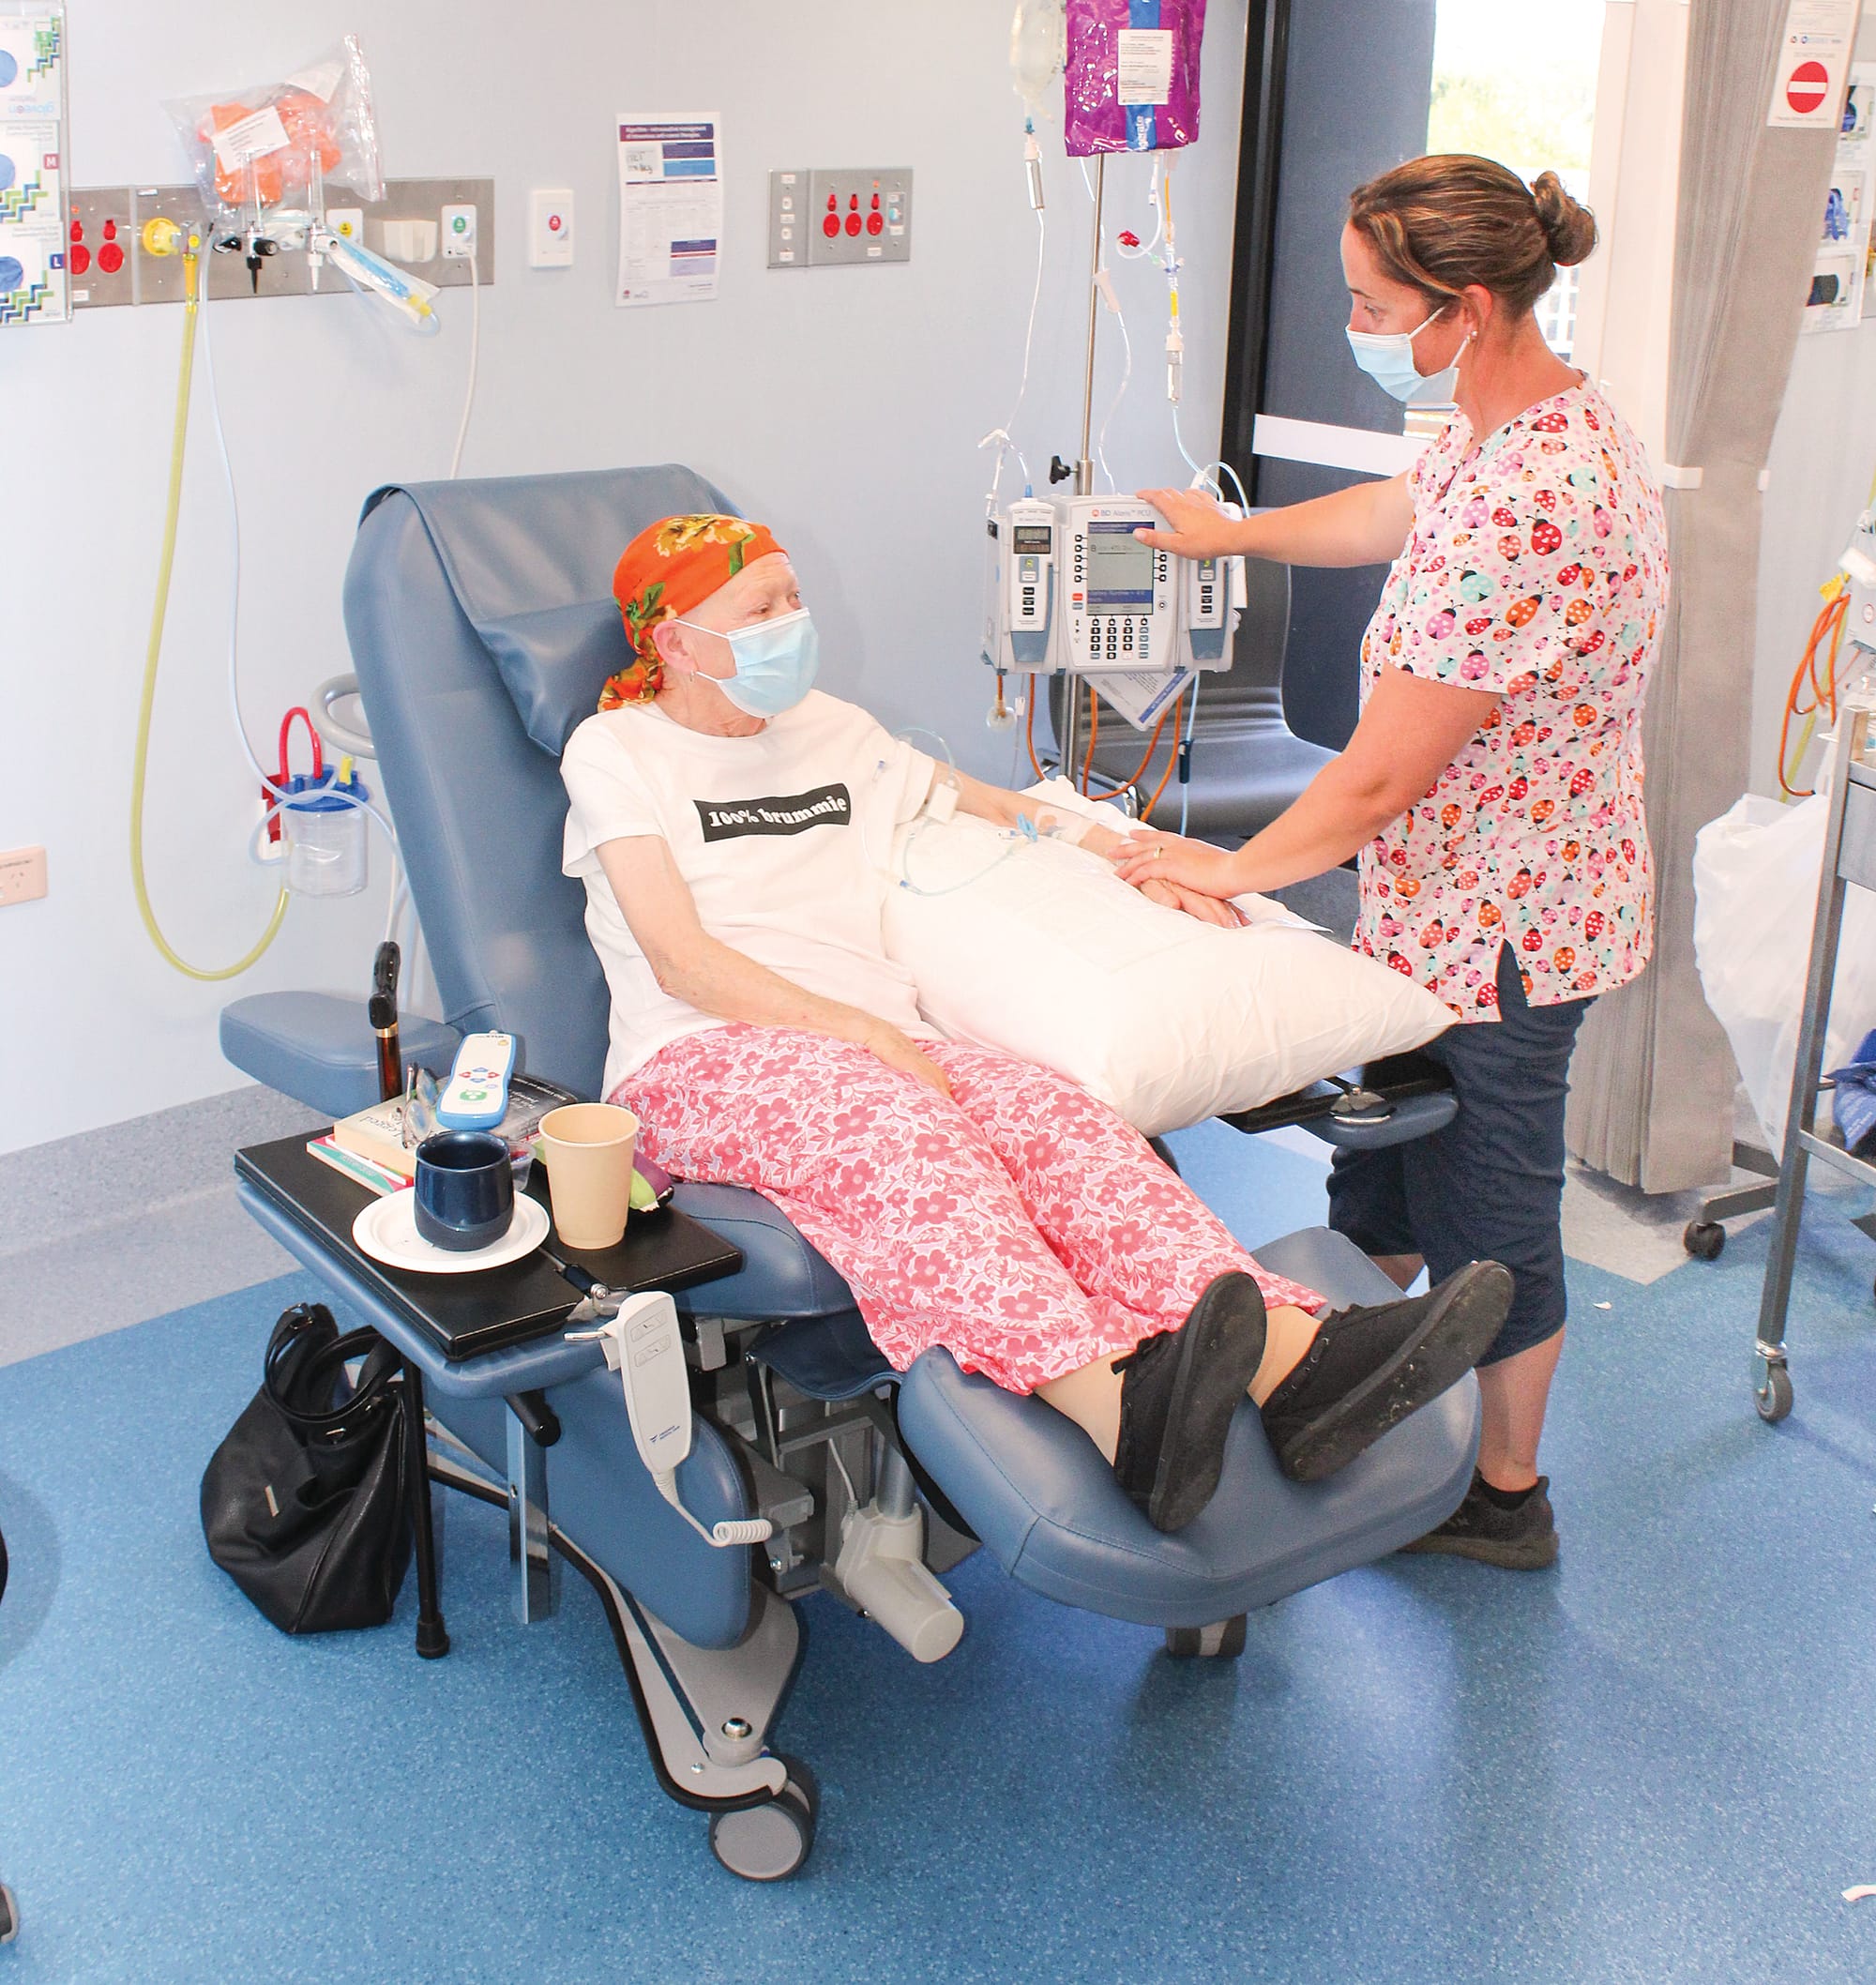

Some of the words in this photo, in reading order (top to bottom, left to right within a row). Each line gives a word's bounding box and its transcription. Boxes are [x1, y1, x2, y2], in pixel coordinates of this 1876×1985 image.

[46, 156, 57, 167] M
[53, 256, 61, 267] L
[708, 810, 760, 826] 100%
[757, 796, 847, 825] brummie
